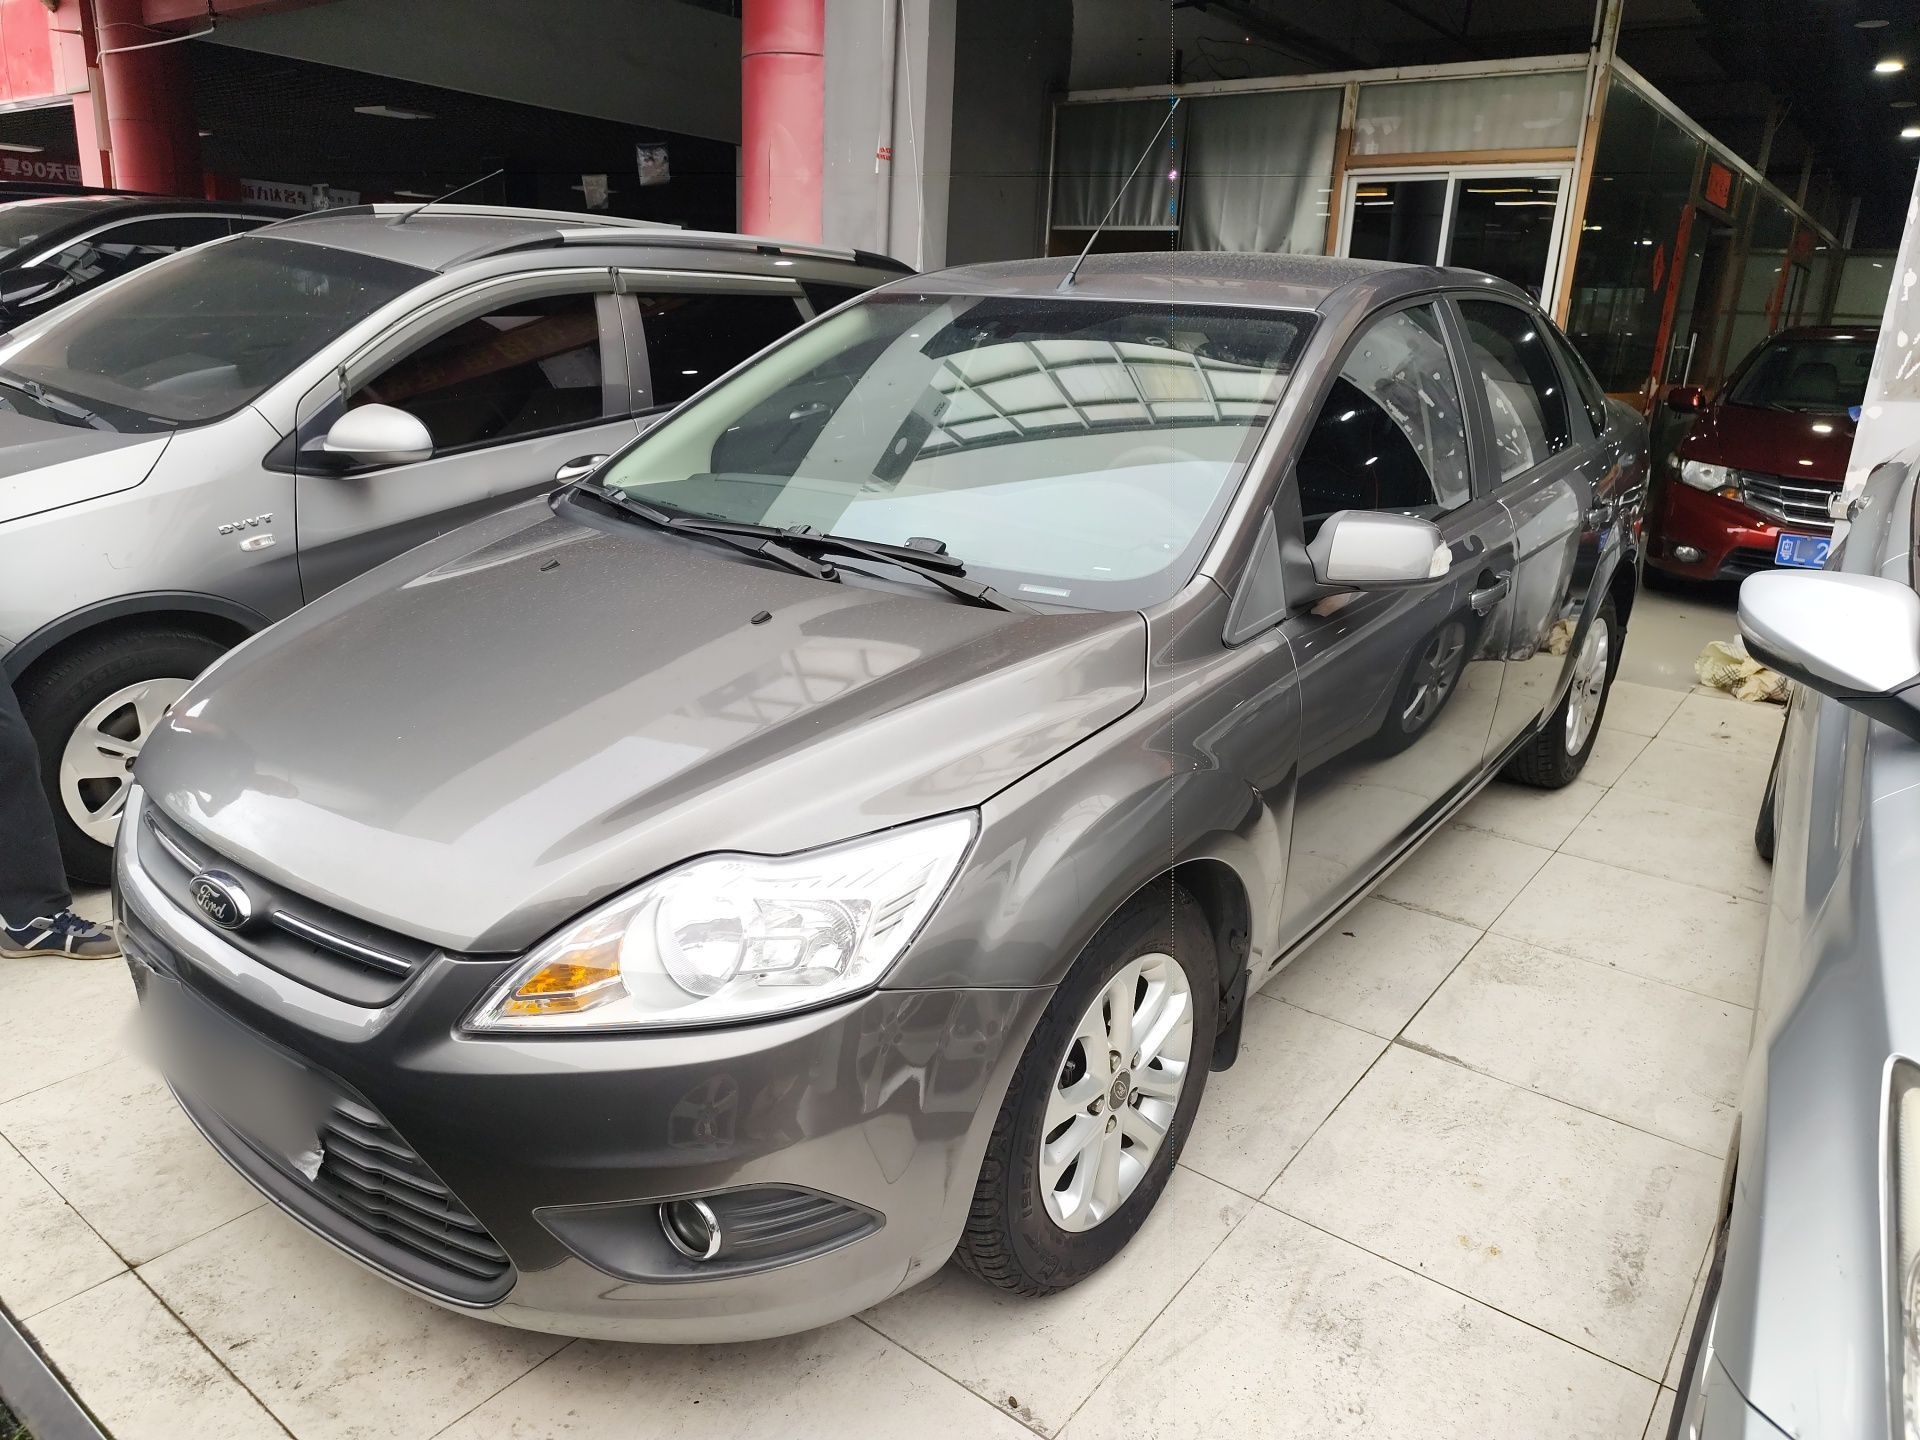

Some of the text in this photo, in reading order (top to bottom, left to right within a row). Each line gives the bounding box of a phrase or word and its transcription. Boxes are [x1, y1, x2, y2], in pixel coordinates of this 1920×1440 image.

[0, 157, 81, 182] 享90天回
[218, 512, 274, 535] DVVT
[196, 884, 227, 919] Ford
